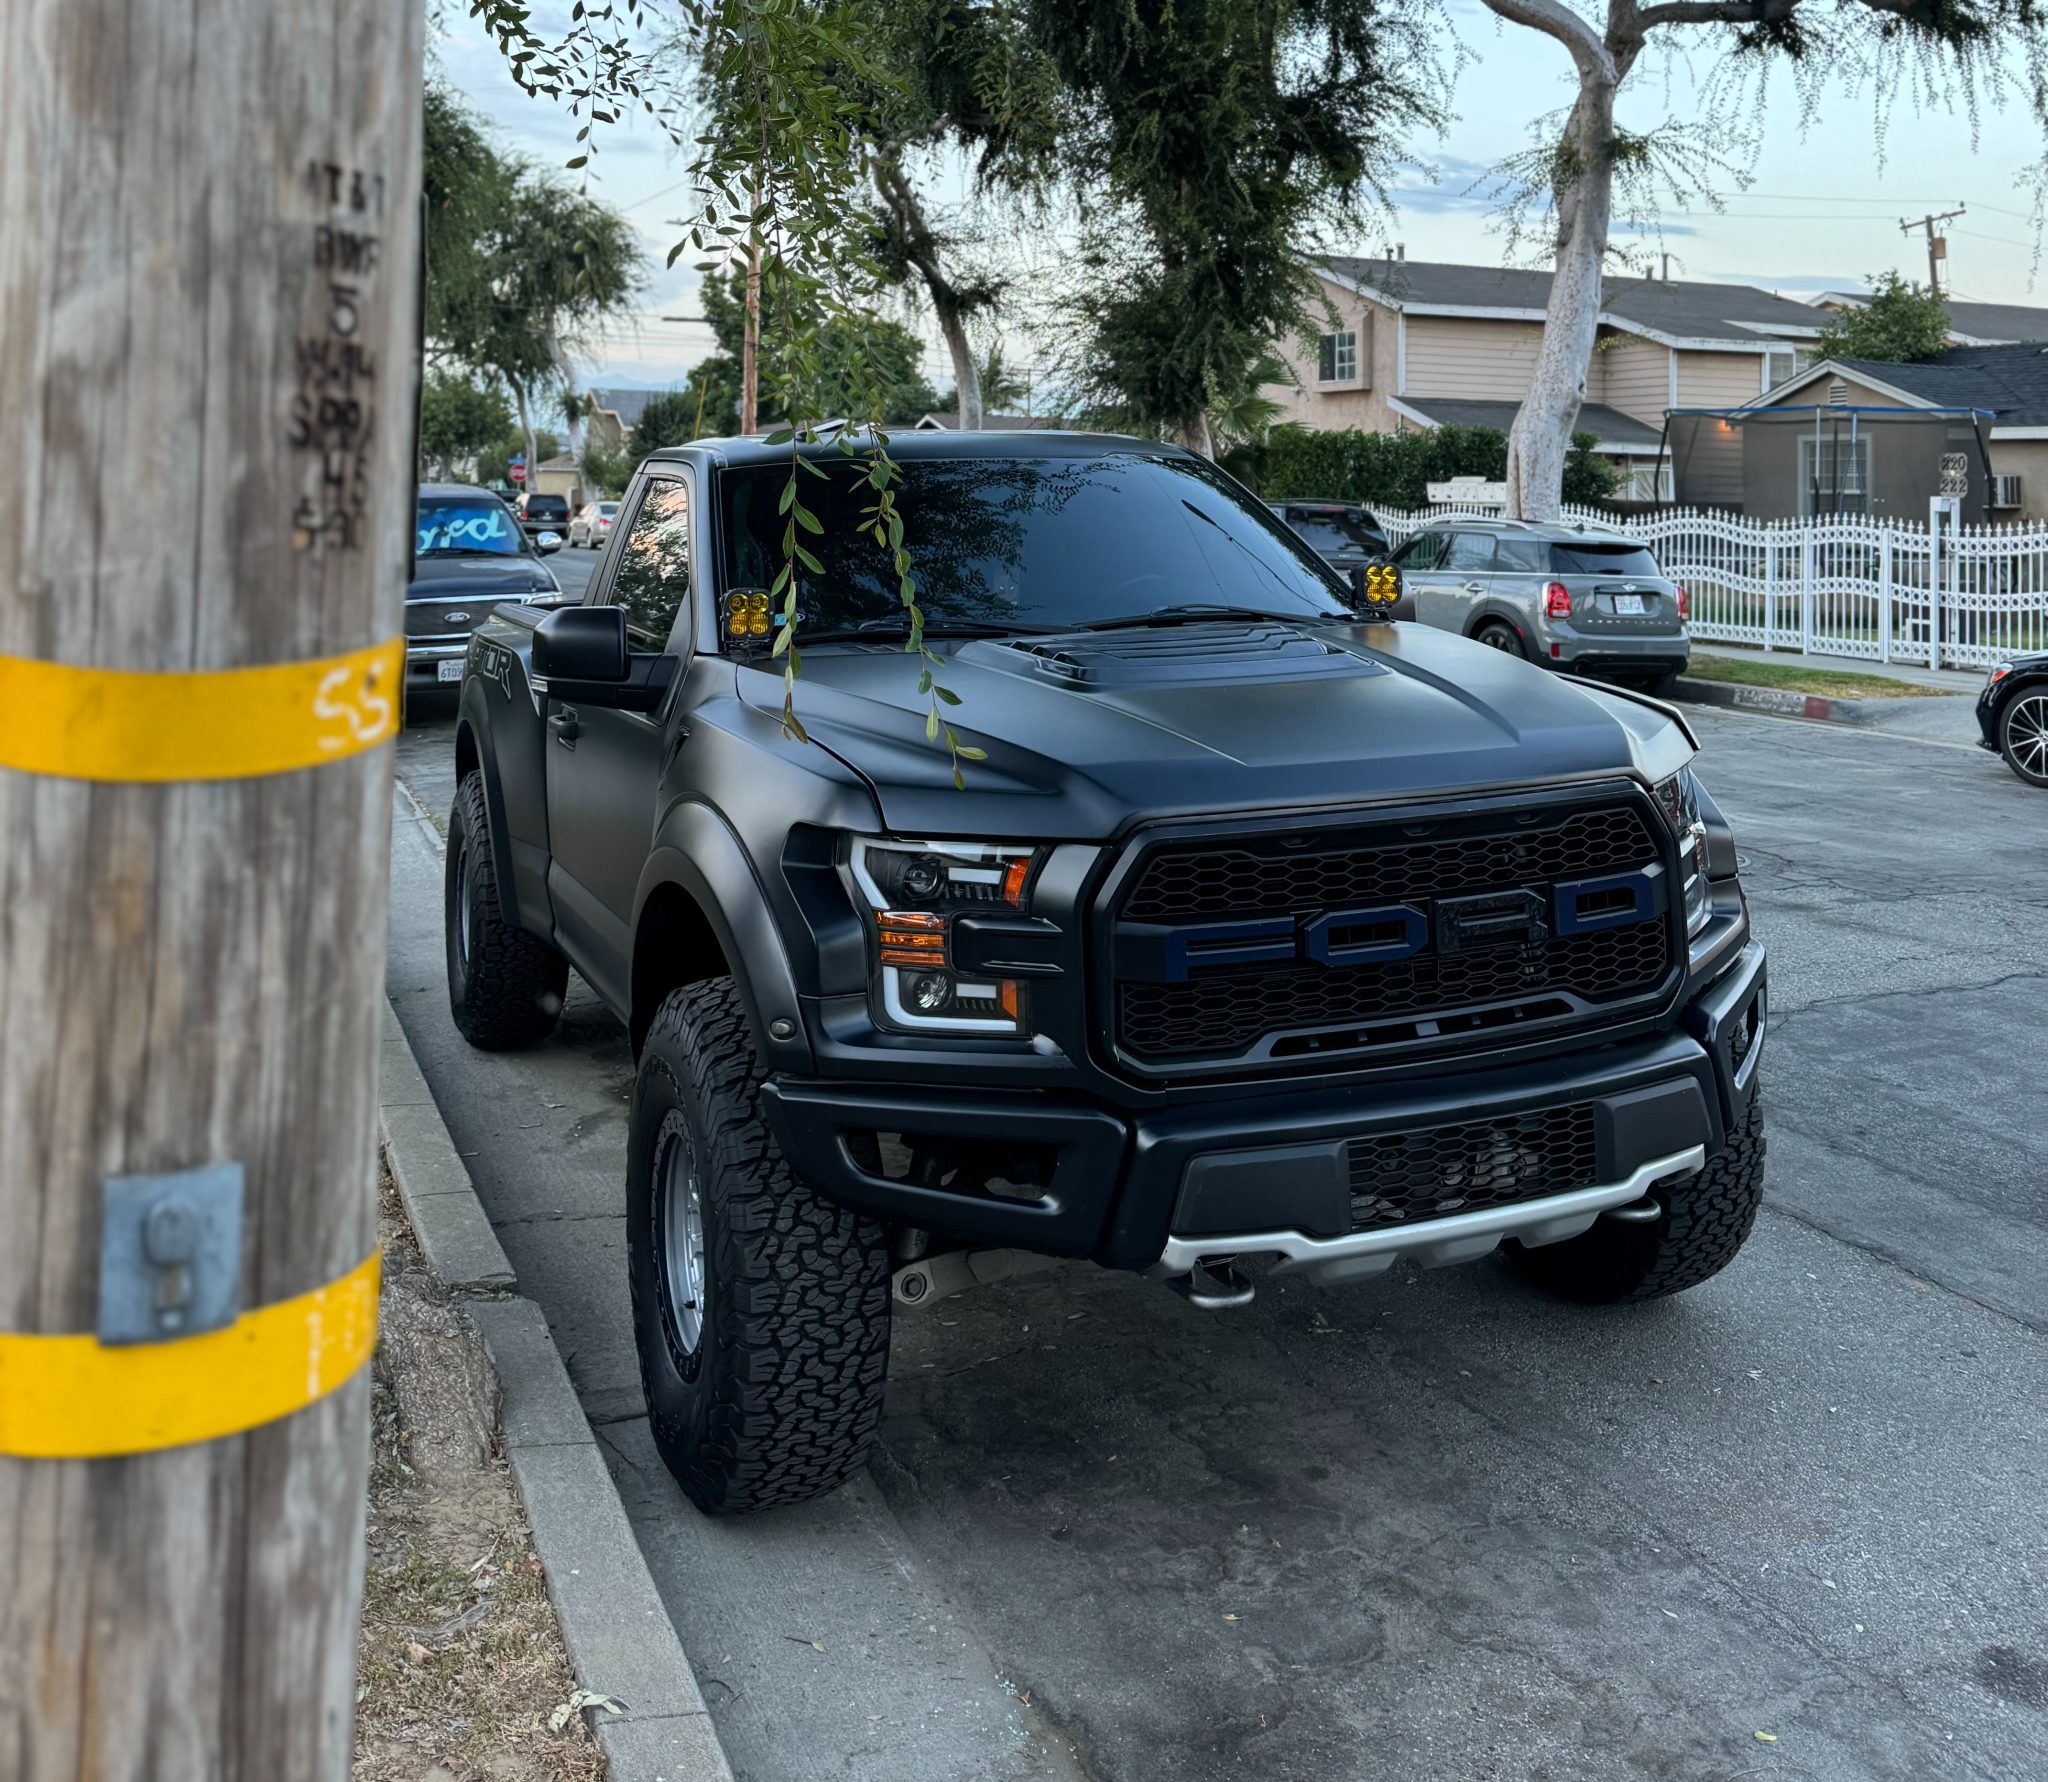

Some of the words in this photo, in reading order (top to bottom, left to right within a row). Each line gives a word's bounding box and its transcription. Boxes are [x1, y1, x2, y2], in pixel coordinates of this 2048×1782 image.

[1941, 455, 1966, 471] 220
[1940, 479, 1968, 493] 222
[1165, 862, 1654, 982] FORD
